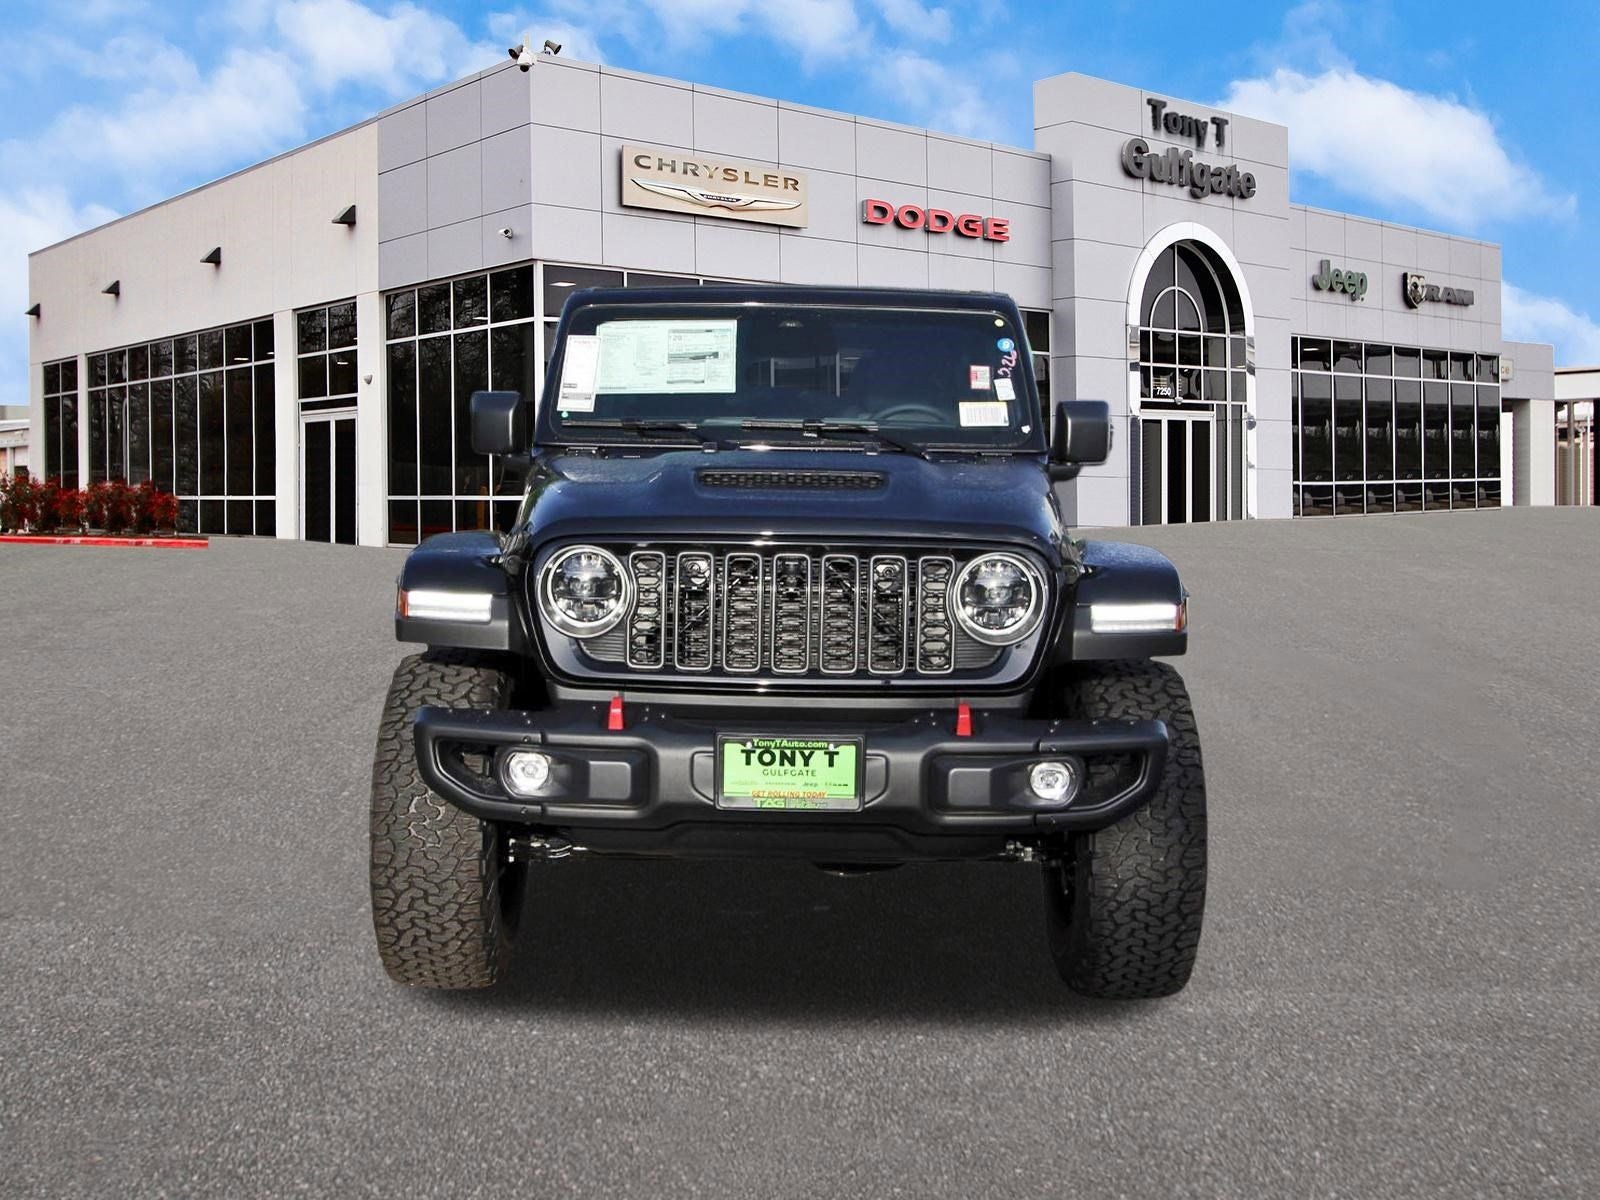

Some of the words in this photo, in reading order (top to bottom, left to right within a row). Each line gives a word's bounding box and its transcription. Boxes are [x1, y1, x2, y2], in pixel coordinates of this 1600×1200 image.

[1147, 98, 1208, 147] Tony
[1211, 117, 1229, 147] T
[633, 153, 800, 192] CHRYSLER
[1121, 138, 1256, 199] Gulfgate
[862, 198, 1010, 242] DODGE
[1313, 259, 1368, 301] Jeep
[1424, 284, 1474, 306] RAM
[1156, 386, 1172, 396] 7250
[741, 748, 815, 767] TONY
[823, 751, 840, 767] T
[752, 738, 828, 748] TonyTAuto.com
[762, 769, 817, 777] GULFGATE
